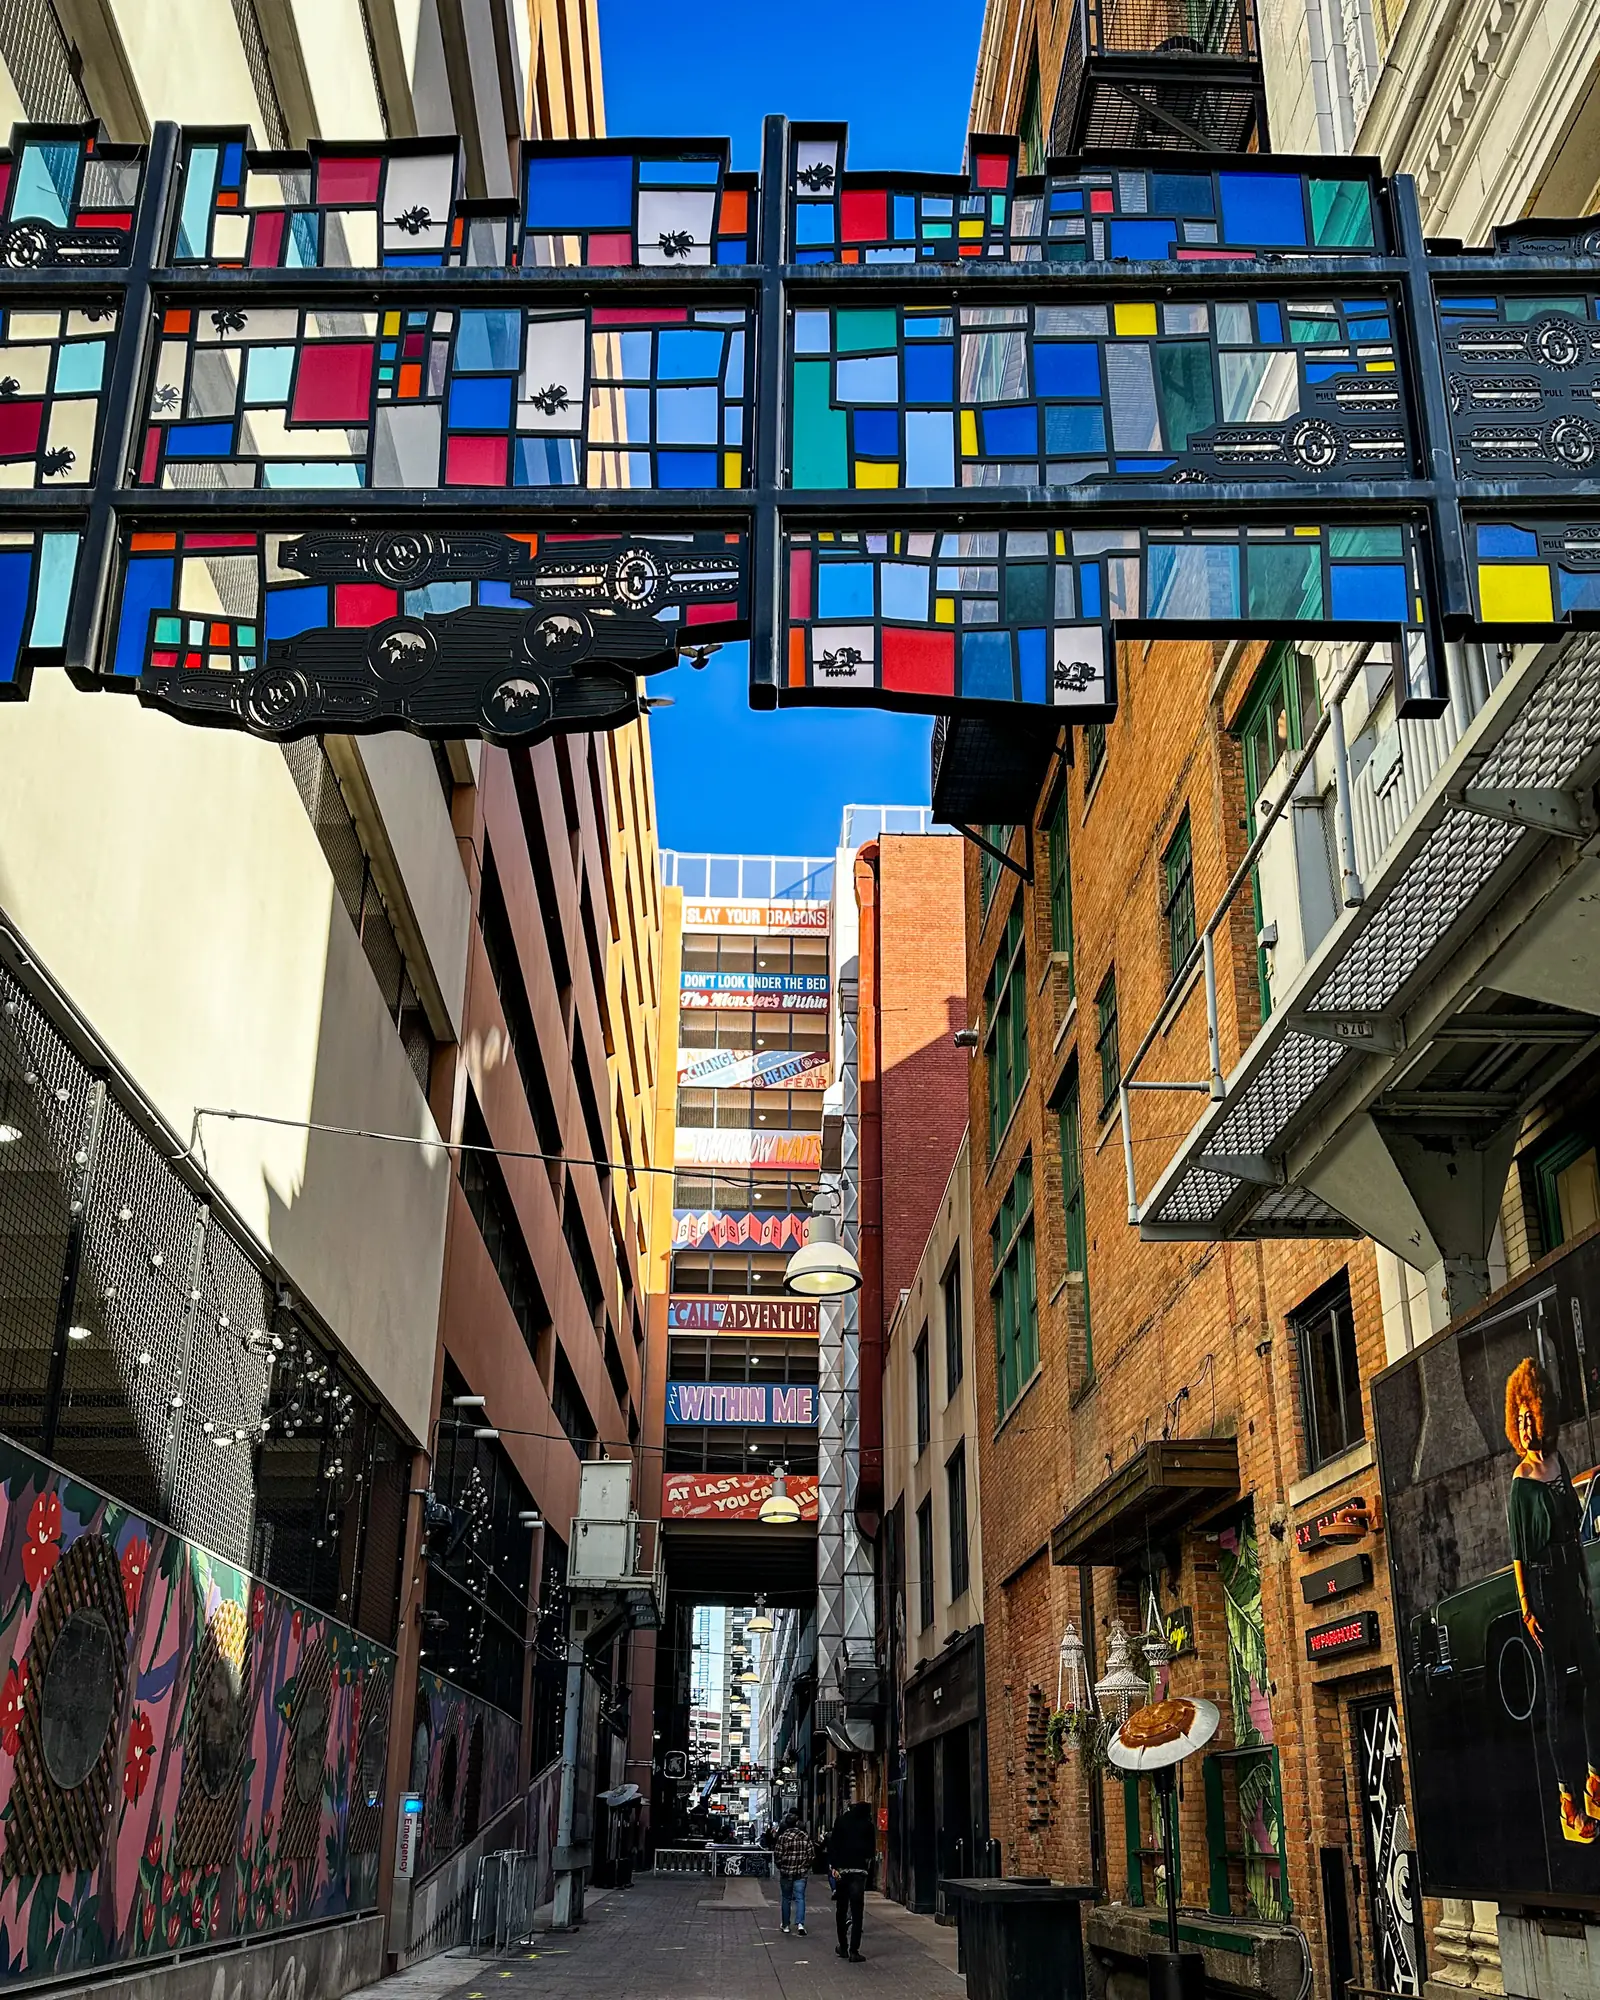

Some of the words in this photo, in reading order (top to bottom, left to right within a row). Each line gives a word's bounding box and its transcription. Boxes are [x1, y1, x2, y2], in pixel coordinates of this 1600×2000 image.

[1316, 392, 1335, 401] PULL
[1544, 389, 1564, 397] PULL
[1571, 389, 1592, 398] PULL
[1543, 540, 1564, 549] PULL
[686, 907, 721, 925] SLAY
[726, 908, 760, 926] YOUR
[766, 909, 826, 926] DRAGONS
[684, 973, 714, 989] DON'T
[718, 974, 745, 990] LOOK
[747, 975, 782, 990] UNDER
[783, 976, 803, 990] THE
[806, 977, 827, 991] BED
[680, 990, 709, 1008] The
[710, 991, 780, 1009] Monster's
[782, 994, 828, 1010] Within
[687, 1050, 737, 1080] CHANGE
[762, 1059, 803, 1086] HEART
[784, 1077, 827, 1089] FEAR
[693, 1133, 777, 1164] TOMORROW
[680, 1222, 748, 1238] BECAUSE
[764, 1225, 780, 1238] OF
[669, 1302, 675, 1310] A
[675, 1302, 719, 1328] CALL
[716, 1303, 726, 1311] TO
[721, 1303, 819, 1330] ADVENTUR
[678, 1385, 766, 1423] WITHIN
[772, 1387, 813, 1424] ME
[667, 1486, 690, 1502] AT
[694, 1477, 741, 1499] LAST
[712, 1493, 750, 1513] YOU
[749, 1483, 773, 1502] CA
[399, 1818, 413, 1873] Emergency
